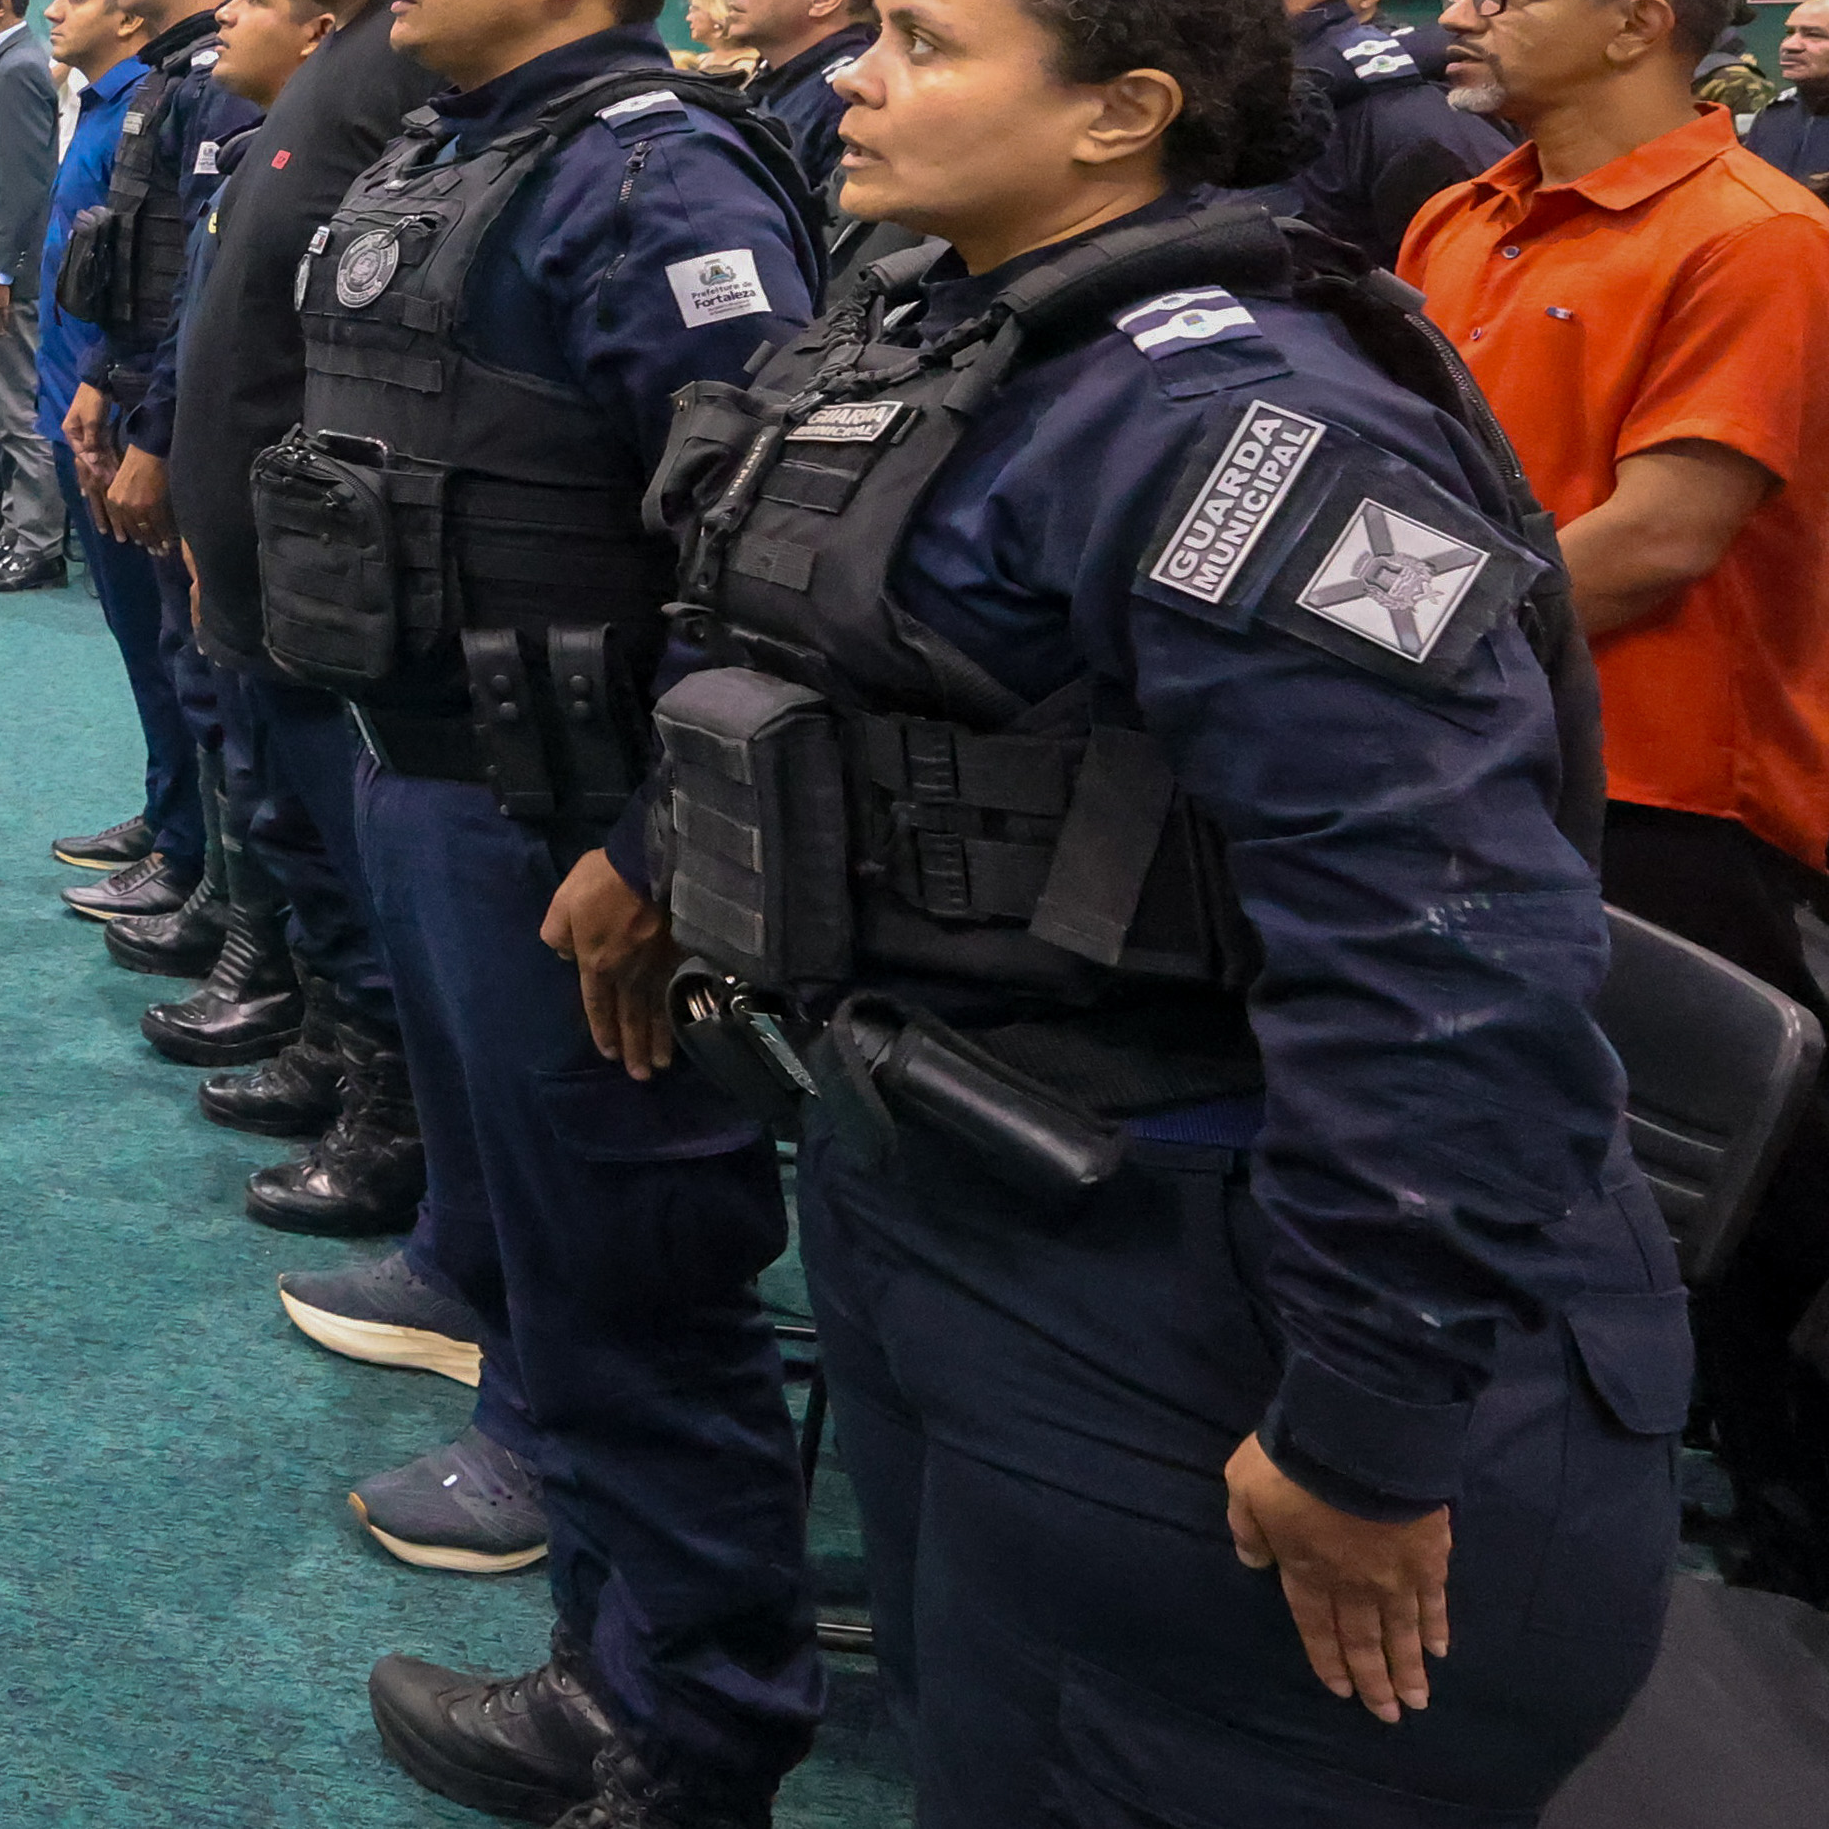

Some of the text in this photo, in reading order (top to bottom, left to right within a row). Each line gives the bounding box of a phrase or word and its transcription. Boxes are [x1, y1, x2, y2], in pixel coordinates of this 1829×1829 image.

[692, 283, 740, 299] Prefeitura
[695, 290, 756, 309] Fortaleza
[807, 406, 889, 425] GUARDA
[792, 424, 874, 437] MUNICIPAL
[1169, 418, 1283, 579] GUARDA
[1192, 428, 1311, 591] MUNICIPAL
